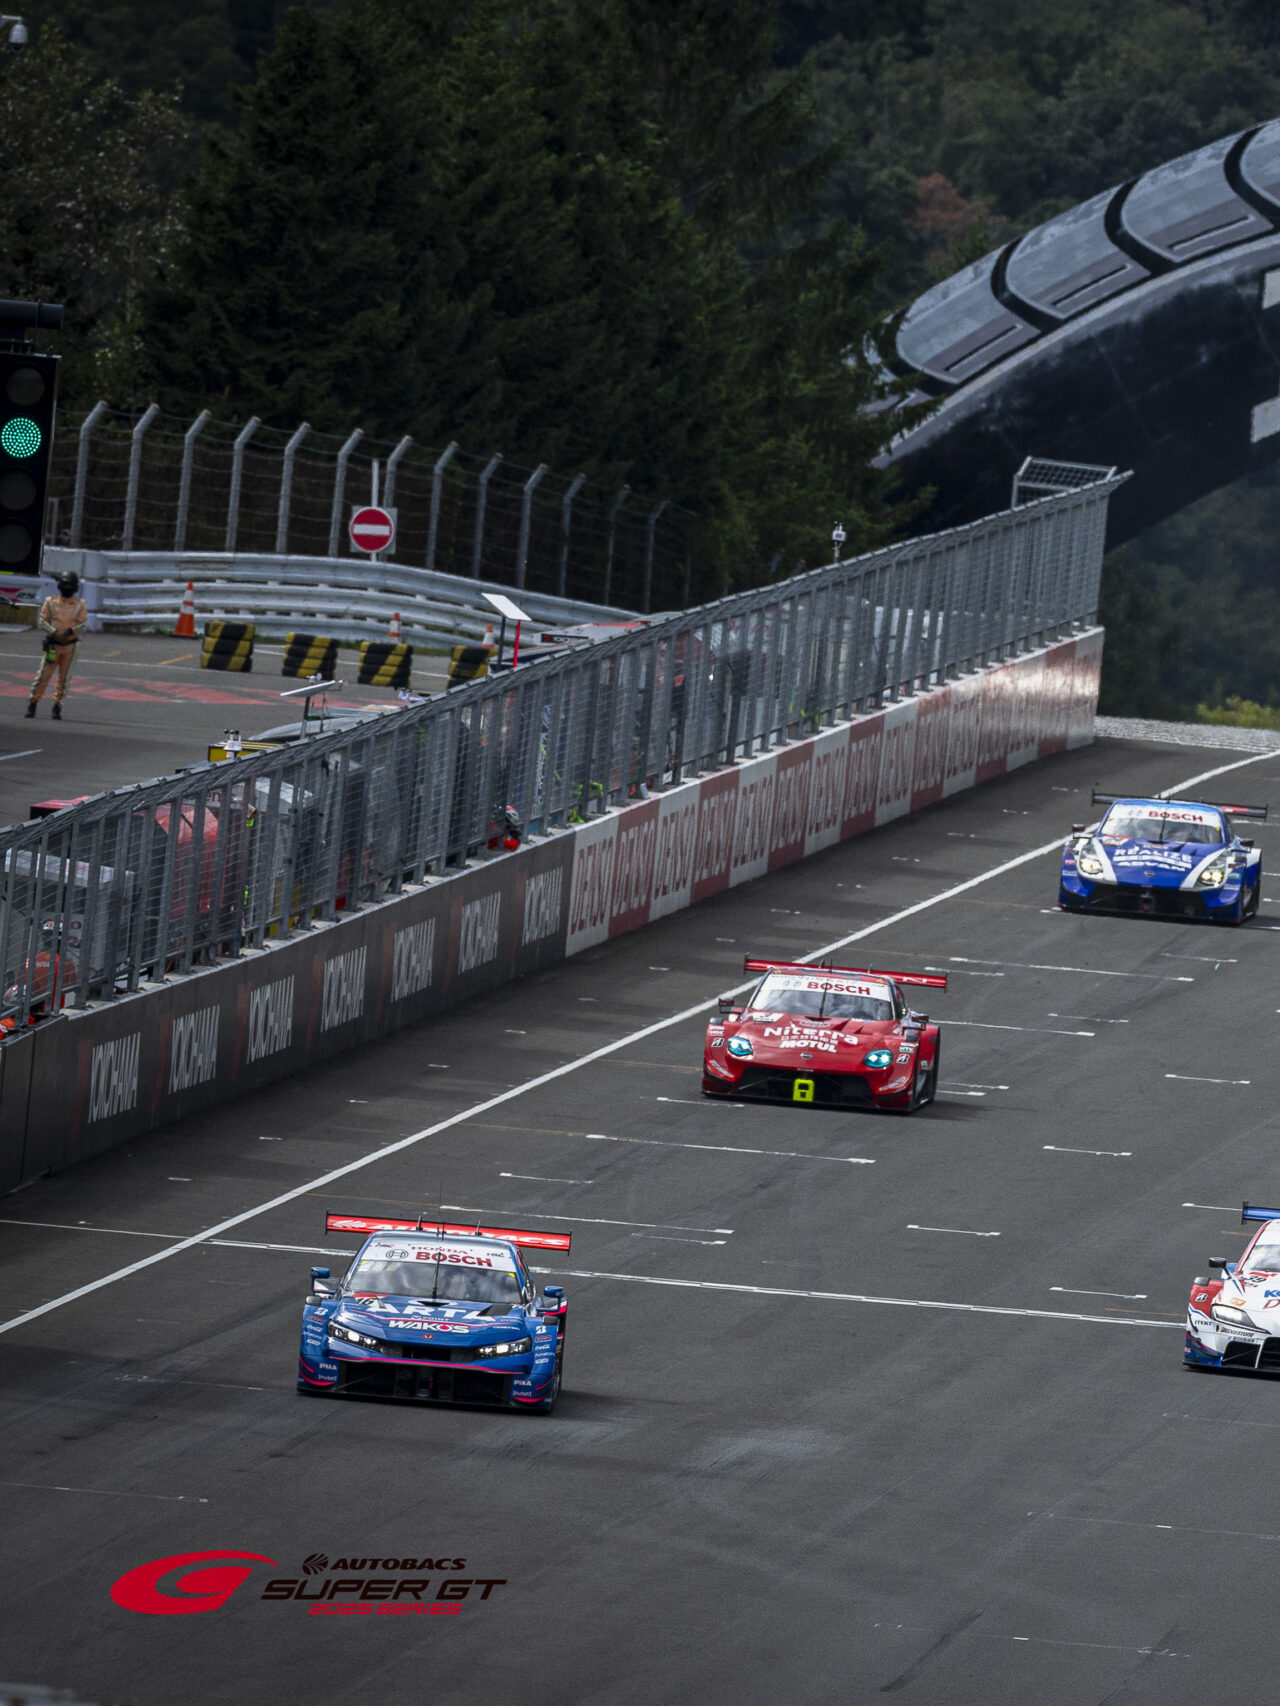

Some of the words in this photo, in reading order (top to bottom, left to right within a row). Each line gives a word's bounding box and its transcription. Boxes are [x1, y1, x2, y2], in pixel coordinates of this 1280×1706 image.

[1148, 810, 1203, 822] BOSCH
[807, 981, 871, 996] BOSCH
[763, 1026, 859, 1046] Niterra
[780, 1040, 837, 1053] MOTUL
[415, 1251, 493, 1267] BOSCH
